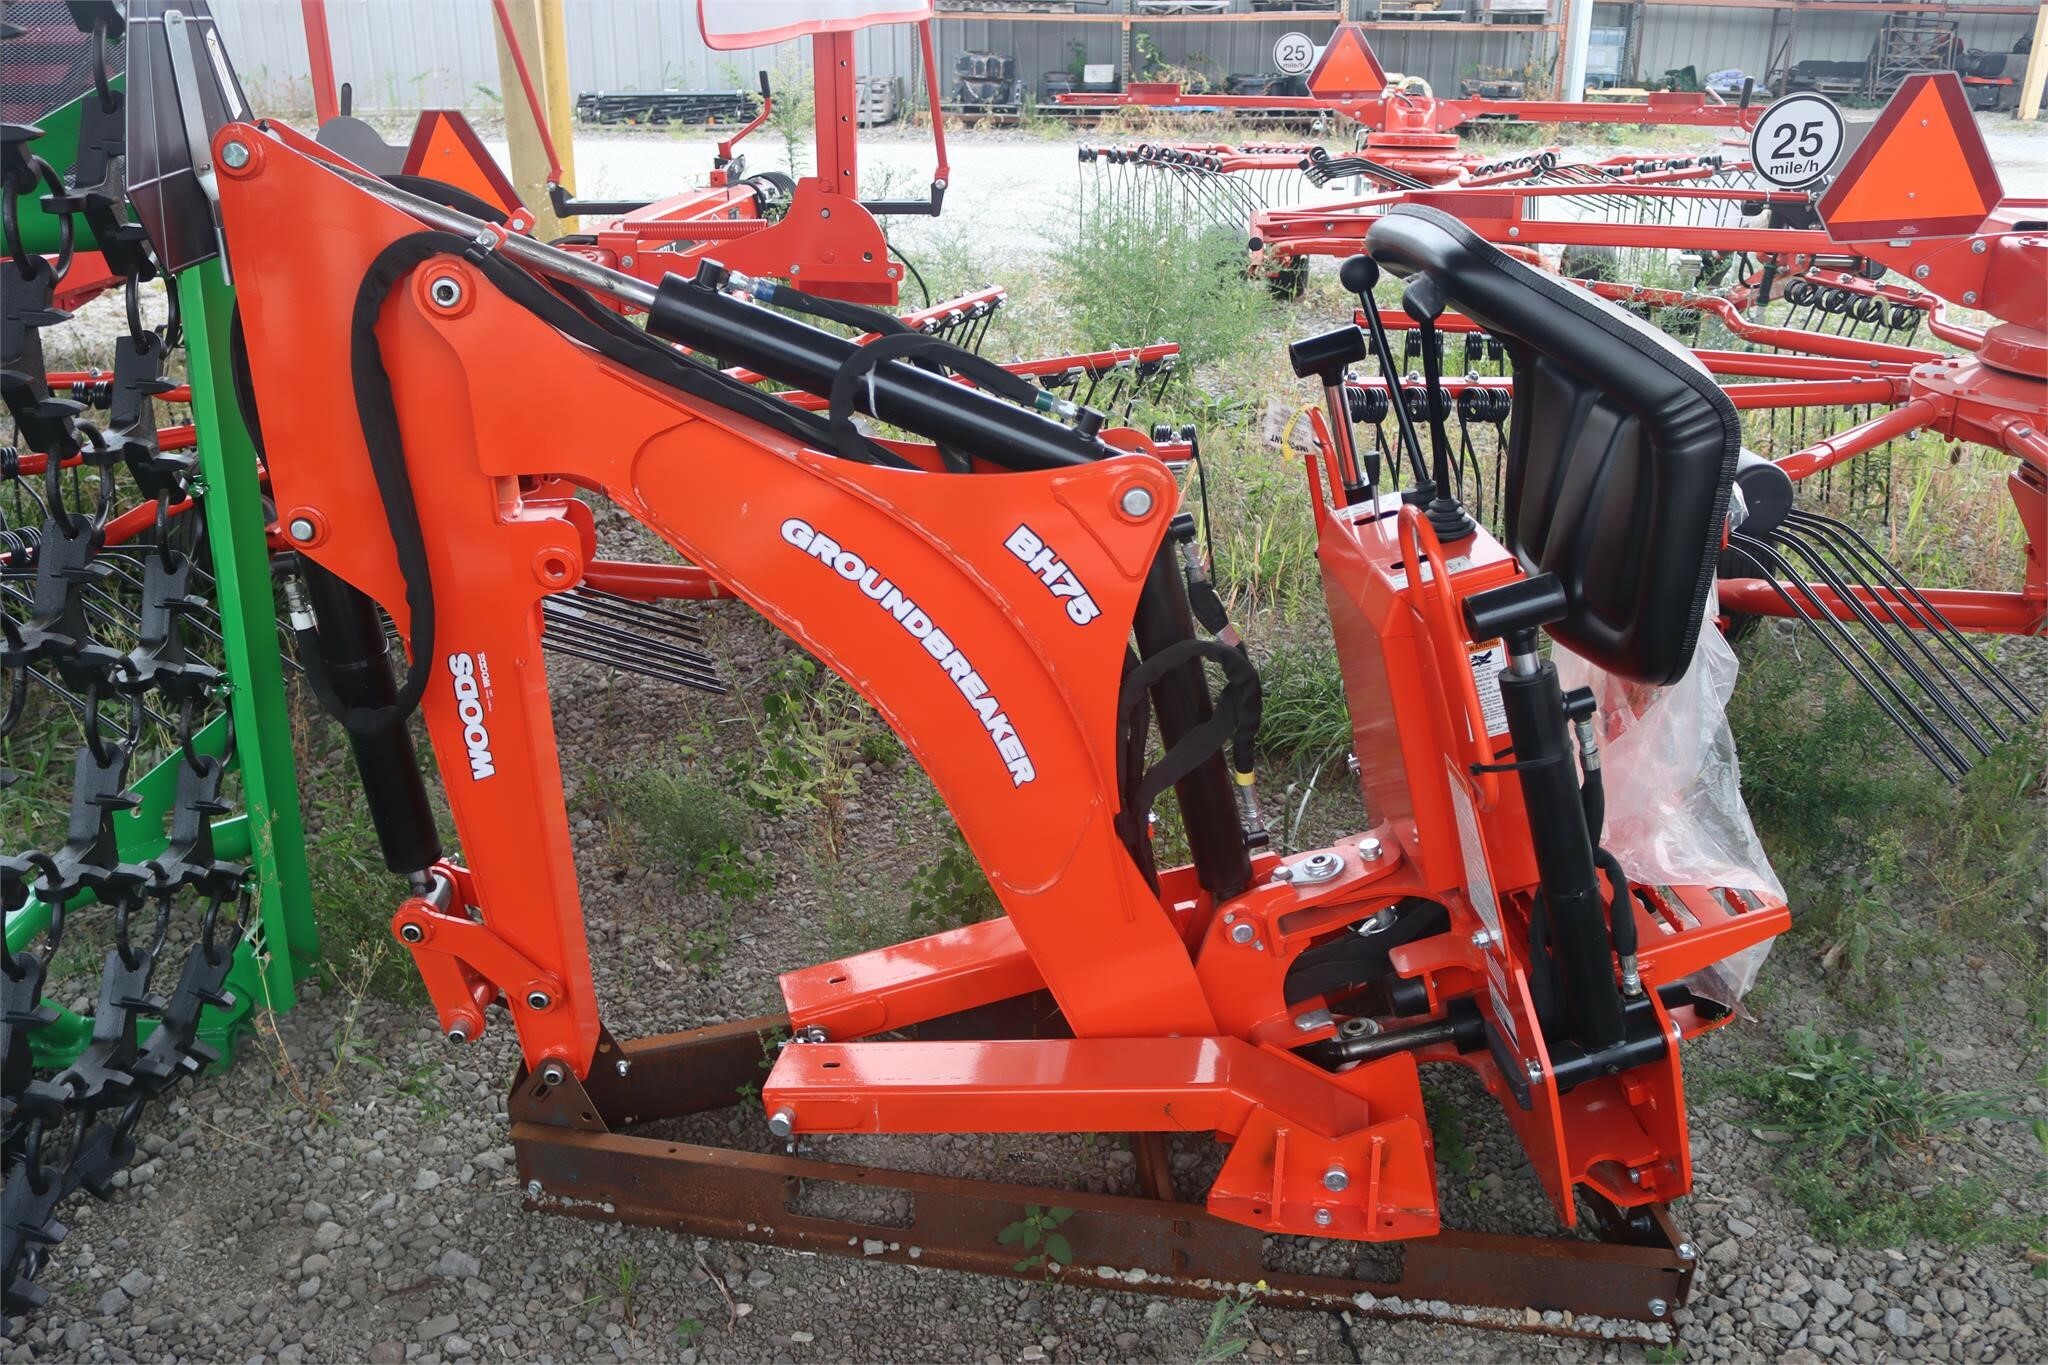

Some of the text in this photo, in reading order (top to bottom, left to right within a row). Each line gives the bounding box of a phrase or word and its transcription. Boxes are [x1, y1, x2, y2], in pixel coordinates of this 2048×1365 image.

[1283, 45, 1305, 61] 25
[1771, 121, 1824, 159] 25
[1769, 159, 1819, 175] mile/h
[1003, 523, 1102, 626] BH75
[780, 518, 1037, 789] GROUNDBREAKER
[1468, 638, 1500, 651] WARNING
[447, 651, 497, 781] WOODS
